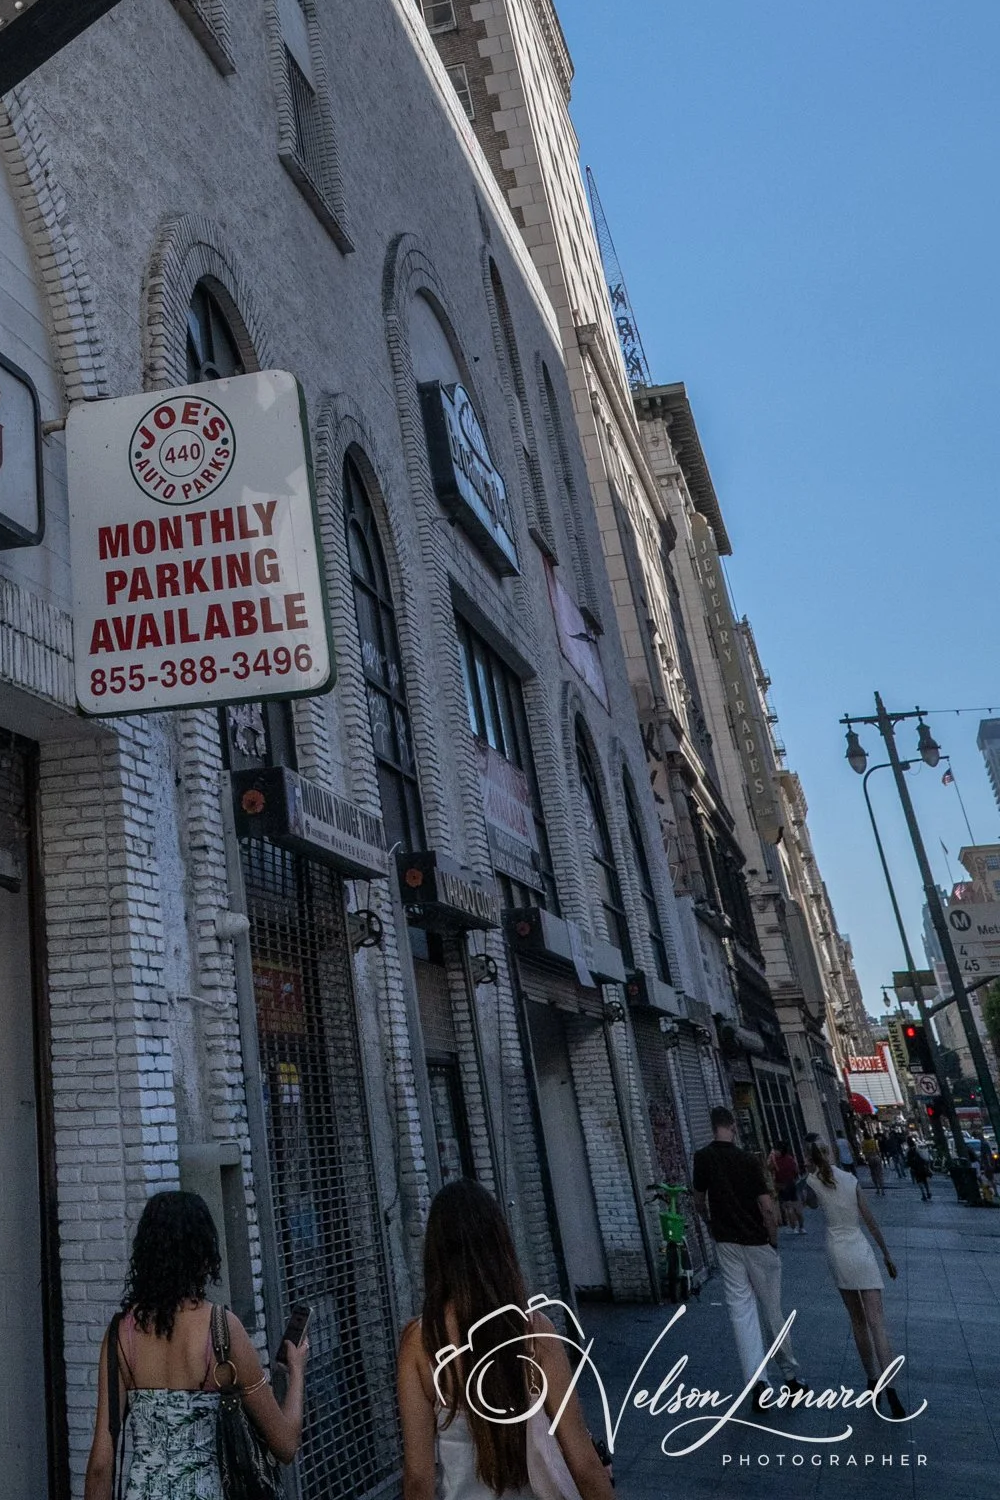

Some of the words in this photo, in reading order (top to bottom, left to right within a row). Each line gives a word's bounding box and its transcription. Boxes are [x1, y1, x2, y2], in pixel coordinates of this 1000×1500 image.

[139, 401, 226, 450] JOE'S
[135, 458, 175, 499] AUTO
[181, 447, 230, 499] PARKS
[165, 443, 201, 464] 440
[98, 500, 278, 560] MONTHLY
[105, 548, 281, 605] PARKING
[89, 592, 309, 655] AVAILABLE
[90, 644, 313, 697] 855-388-3496
[699, 540, 734, 663] JEWELRY
[731, 682, 765, 794] TRADES
[300, 779, 335, 827] MOULIN
[333, 796, 362, 840] ROUGE
[960, 945, 969, 957] 4
[964, 959, 980, 972] 45
